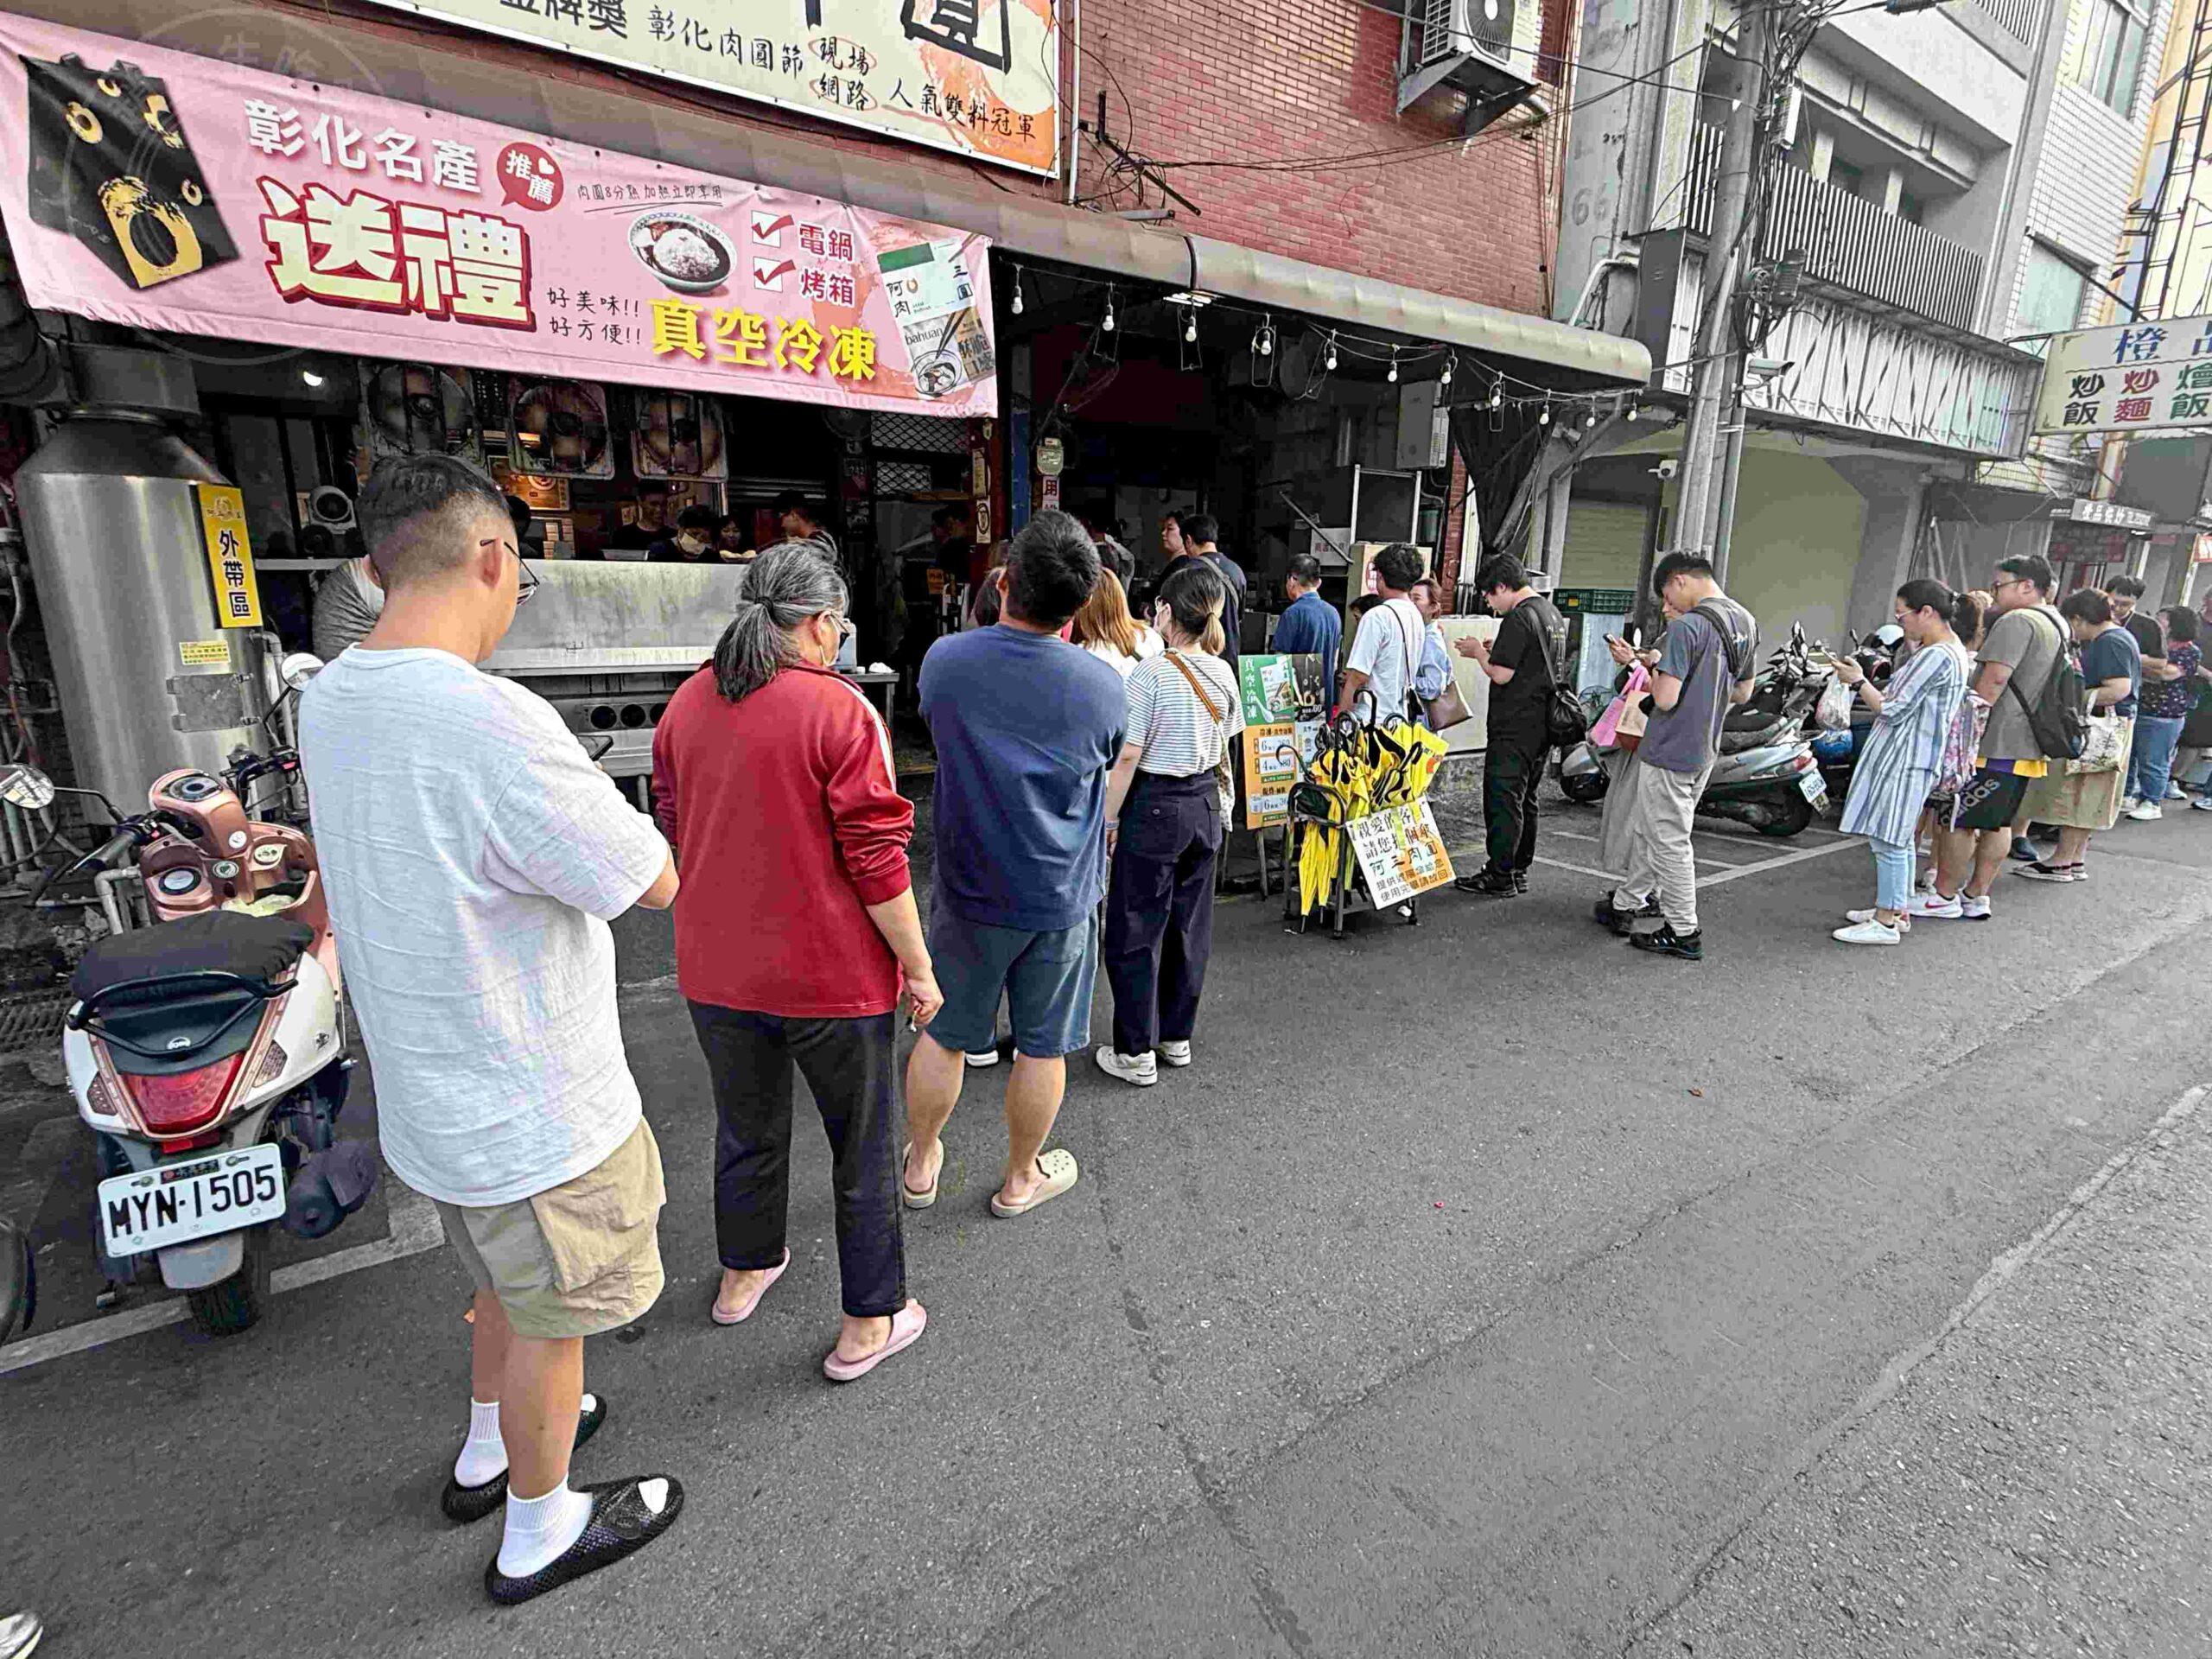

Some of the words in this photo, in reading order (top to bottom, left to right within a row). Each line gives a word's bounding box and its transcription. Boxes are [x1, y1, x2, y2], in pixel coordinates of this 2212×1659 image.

[648, 6, 803, 79] 彰化肉圓節
[819, 36, 869, 76] 現場
[818, 73, 866, 111] 網路
[890, 77, 1036, 142] 人氣雙料冠軍
[244, 99, 482, 194] 彰化名產
[506, 150, 556, 204] 推薦
[257, 176, 536, 330] 送禮
[798, 223, 854, 262] 電鍋
[546, 287, 639, 318] 好美味!!
[800, 269, 855, 305] 烤箱
[549, 316, 641, 345] 好方便!!
[648, 298, 877, 381] 真空冷凍
[2063, 372, 2106, 427] 炒飯
[2170, 361, 2212, 419] 燴飯
[219, 530, 251, 618] 外帶區
[1246, 657, 1259, 719] 真空冷凍
[109, 1164, 276, 1238] MYN-1505
